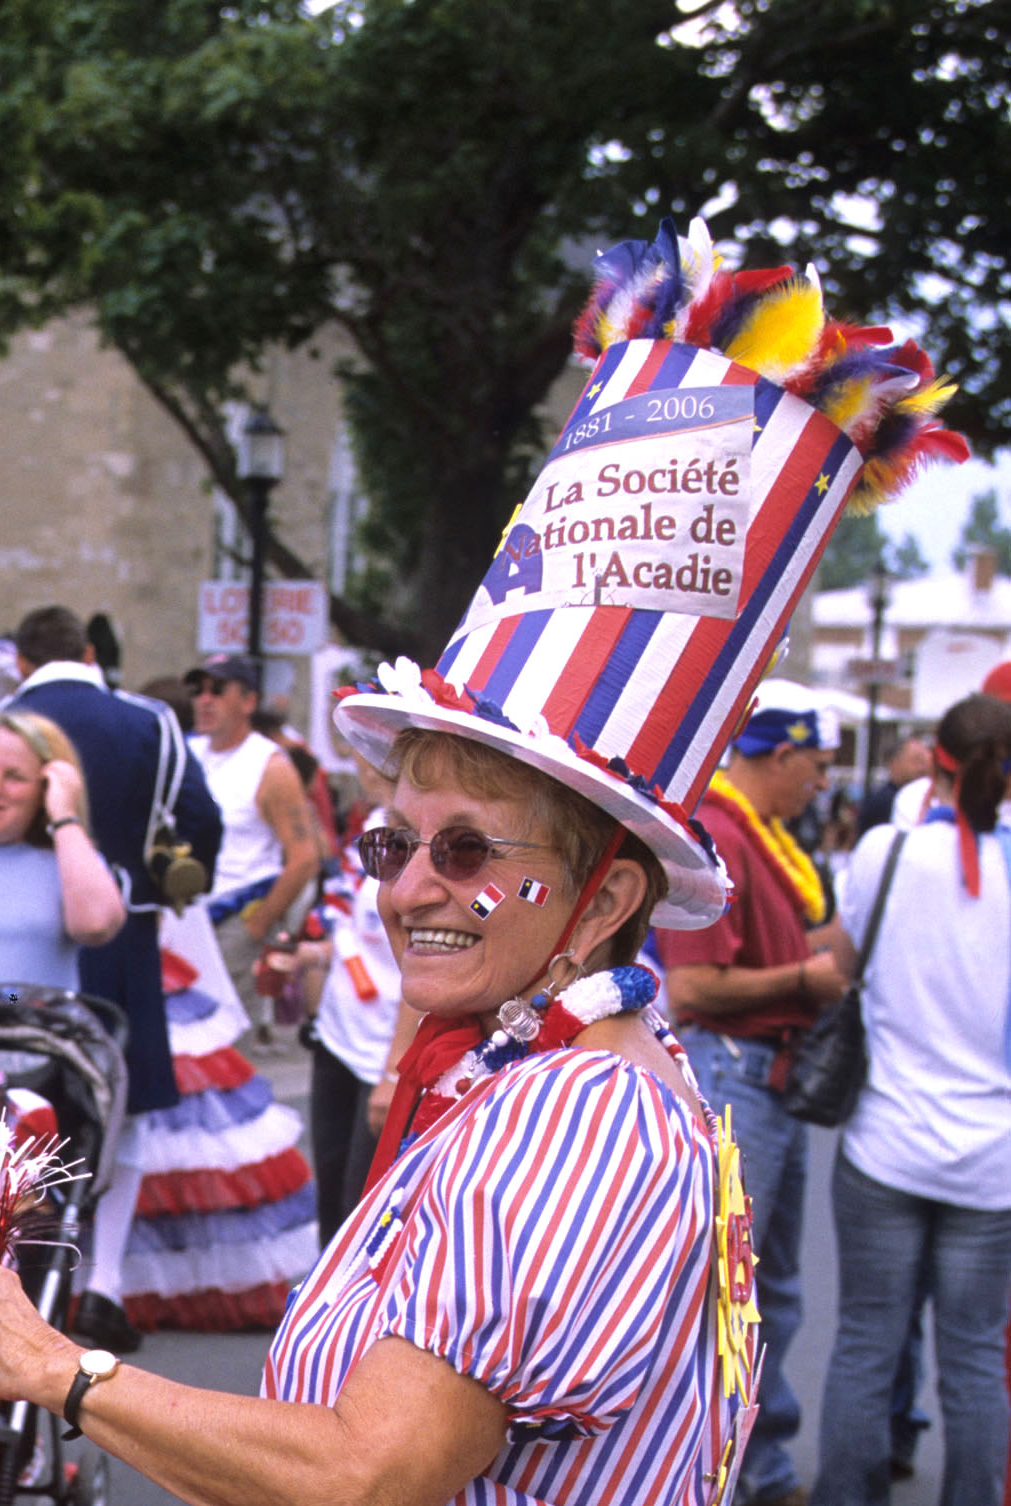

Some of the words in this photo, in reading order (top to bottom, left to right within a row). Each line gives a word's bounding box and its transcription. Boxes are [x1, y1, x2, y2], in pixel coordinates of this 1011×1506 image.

[563, 412, 612, 451] 1881
[645, 395, 715, 422] 2006
[543, 481, 585, 514] La
[596, 458, 740, 497] Société
[498, 502, 677, 573] Nationale
[690, 504, 737, 547] de
[571, 550, 733, 596] l'Acadie
